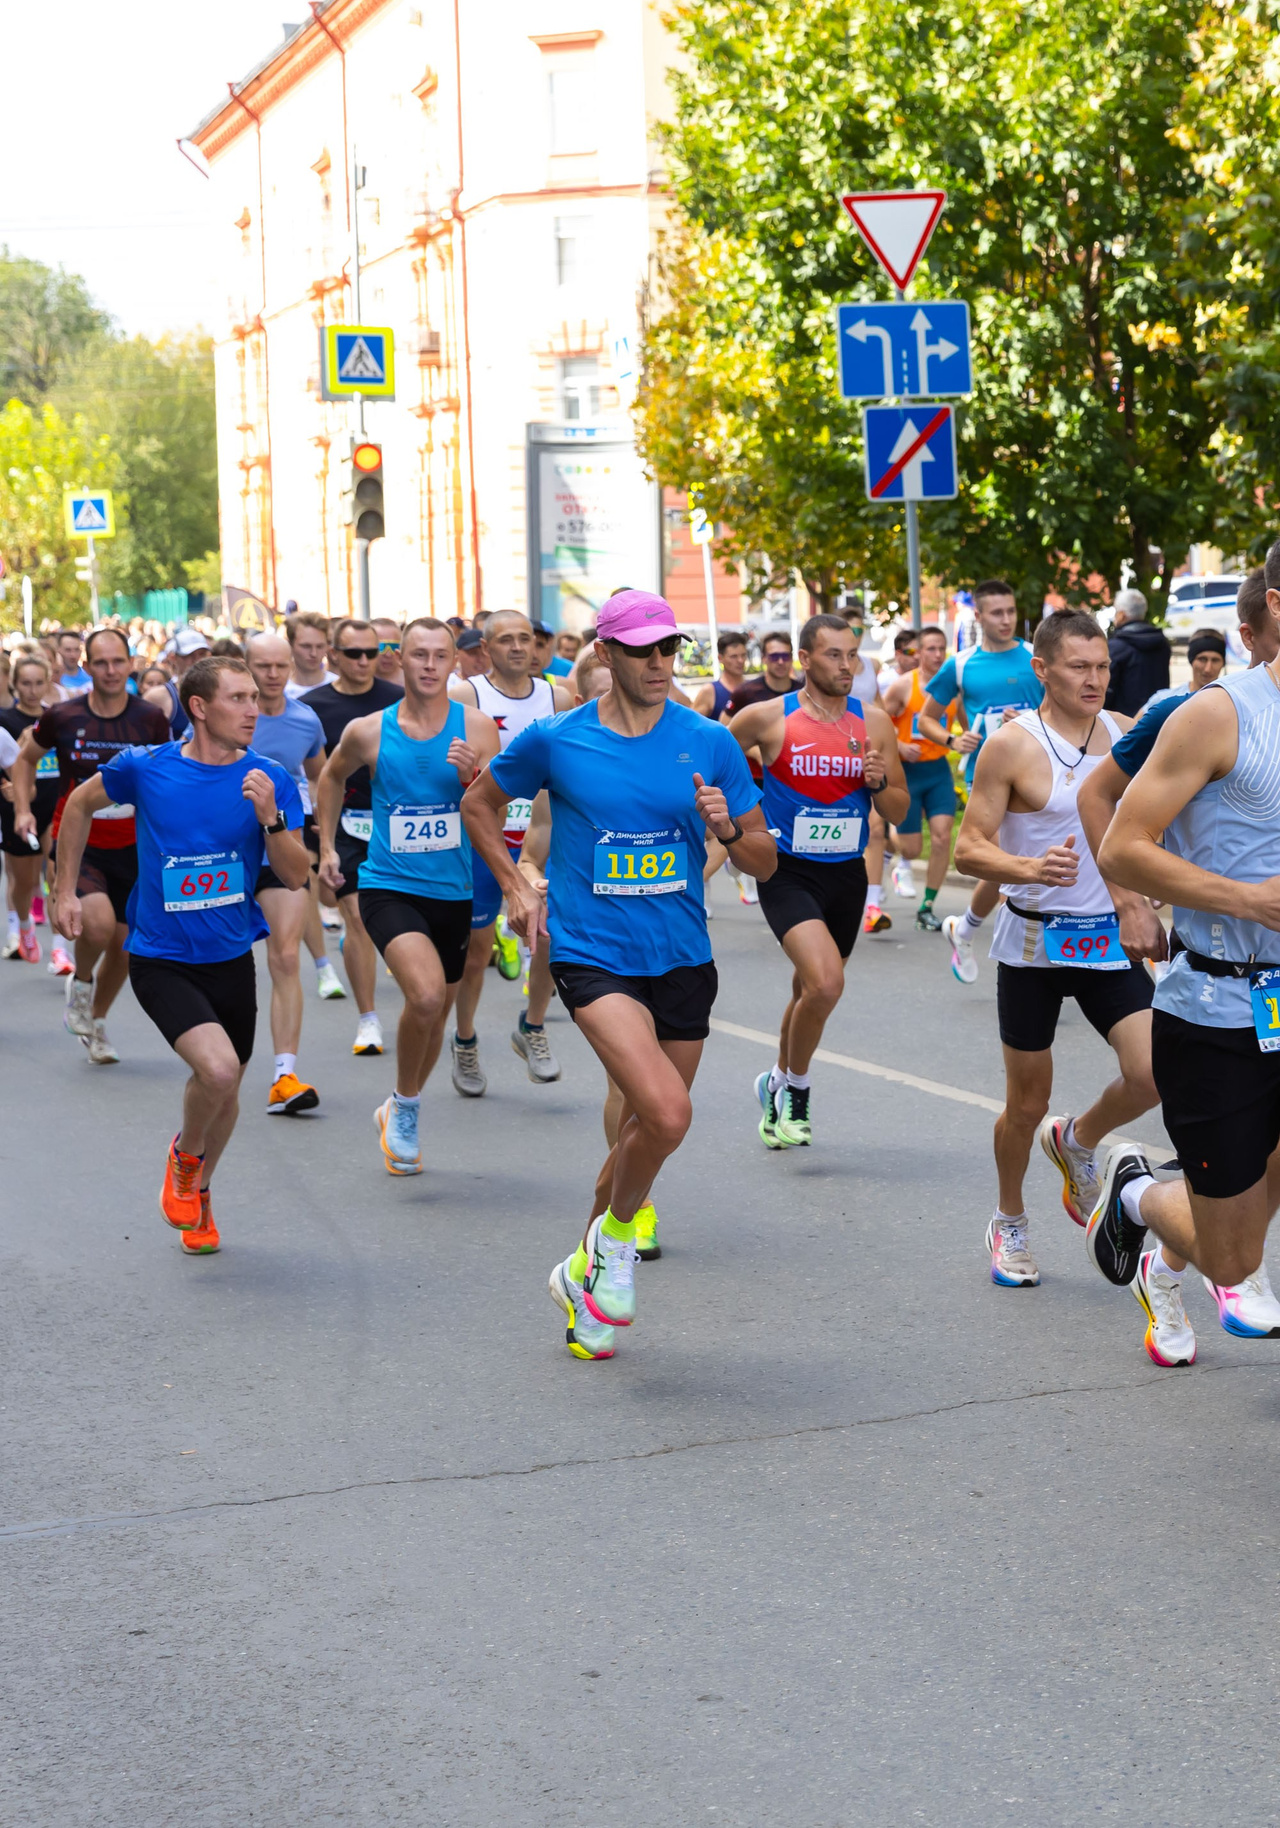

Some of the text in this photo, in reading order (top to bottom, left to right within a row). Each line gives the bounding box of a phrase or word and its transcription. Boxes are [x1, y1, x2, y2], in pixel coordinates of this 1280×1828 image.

[790, 754, 863, 778] RUSSIA
[404, 820, 448, 840] 248
[615, 830, 669, 839] ДИНАМОВСКАЯ
[809, 824, 842, 840] 276
[179, 852, 226, 863] ДИНАМОВСКАЯ
[607, 851, 676, 879] 1182
[180, 870, 230, 896] 692
[1062, 915, 1108, 924] ДИНАМОВСКАЯ
[1060, 935, 1110, 959] 699
